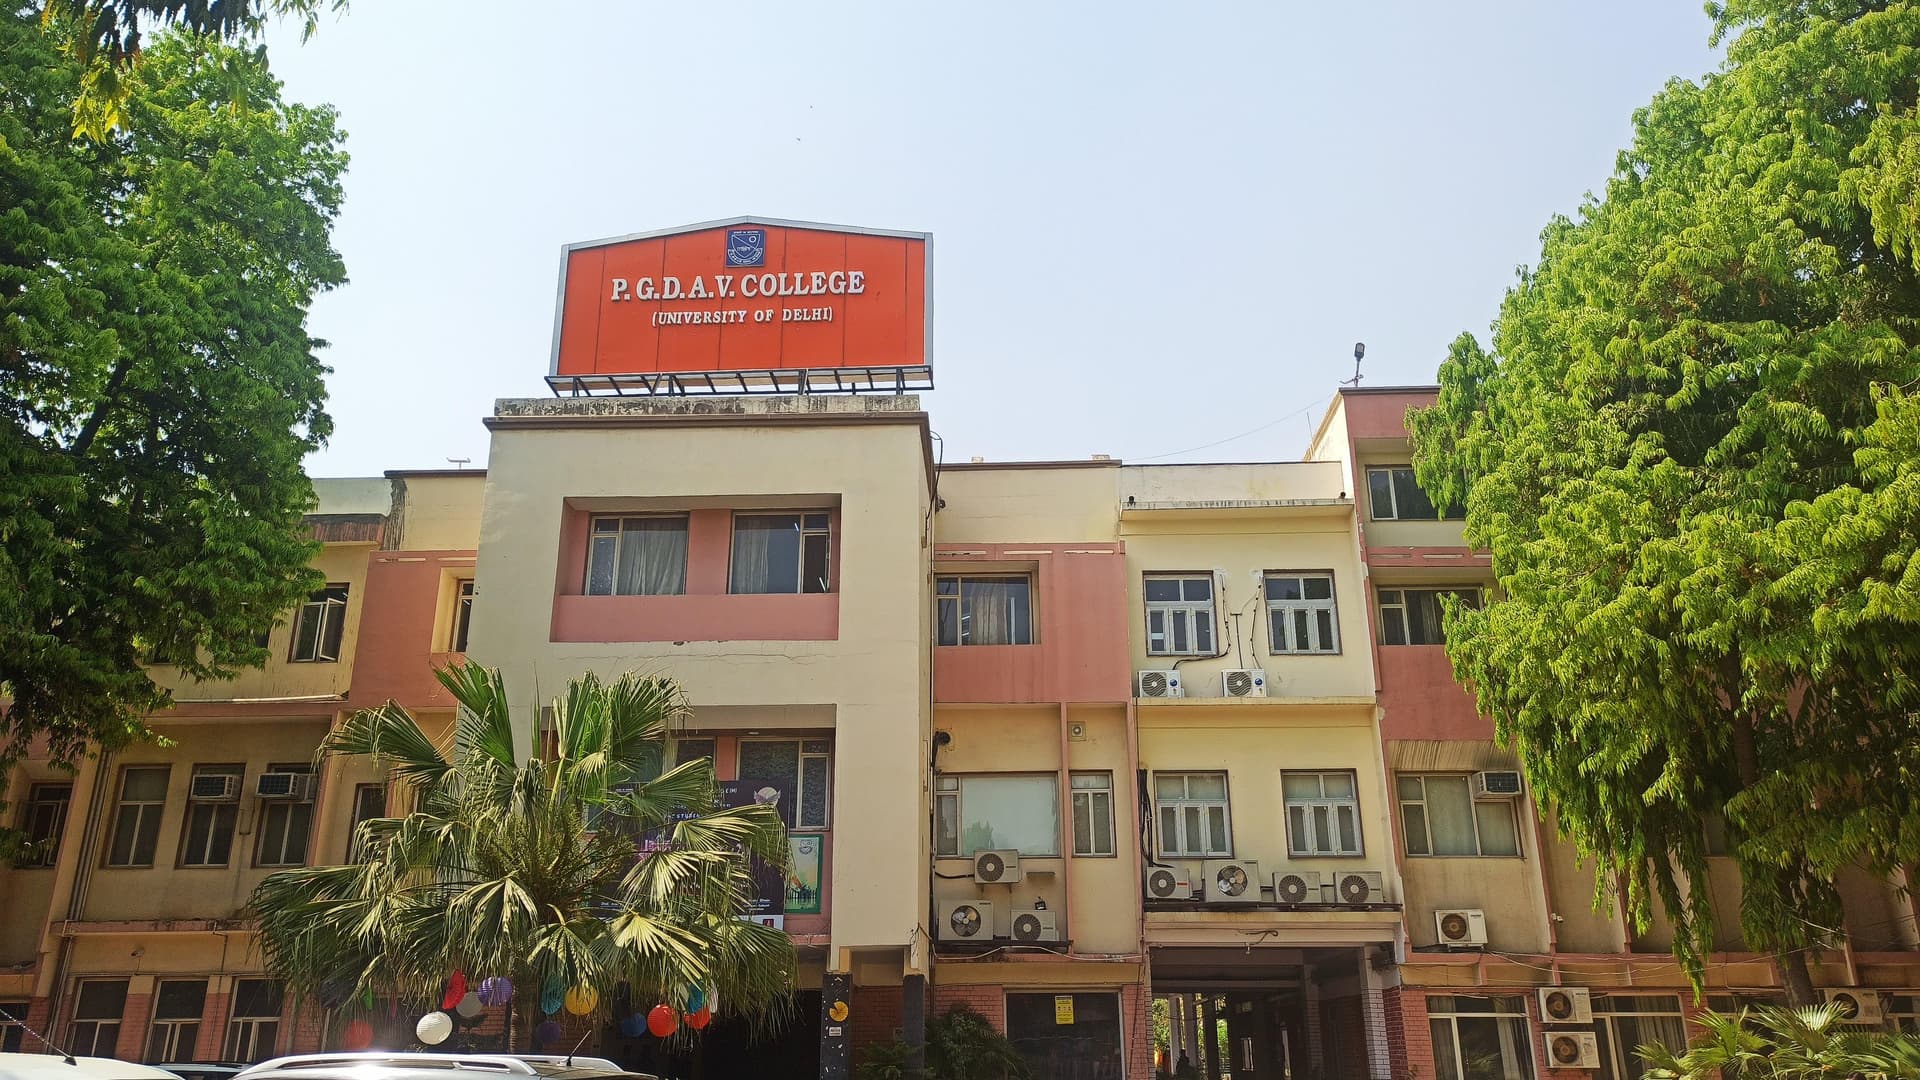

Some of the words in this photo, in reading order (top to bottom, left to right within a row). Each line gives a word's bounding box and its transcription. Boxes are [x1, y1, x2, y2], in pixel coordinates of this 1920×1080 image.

[741, 271, 864, 297] COLLEGE
[652, 310, 747, 327] (UNIVERSITY
[754, 309, 774, 322] OF
[782, 306, 832, 322] DELHI)
